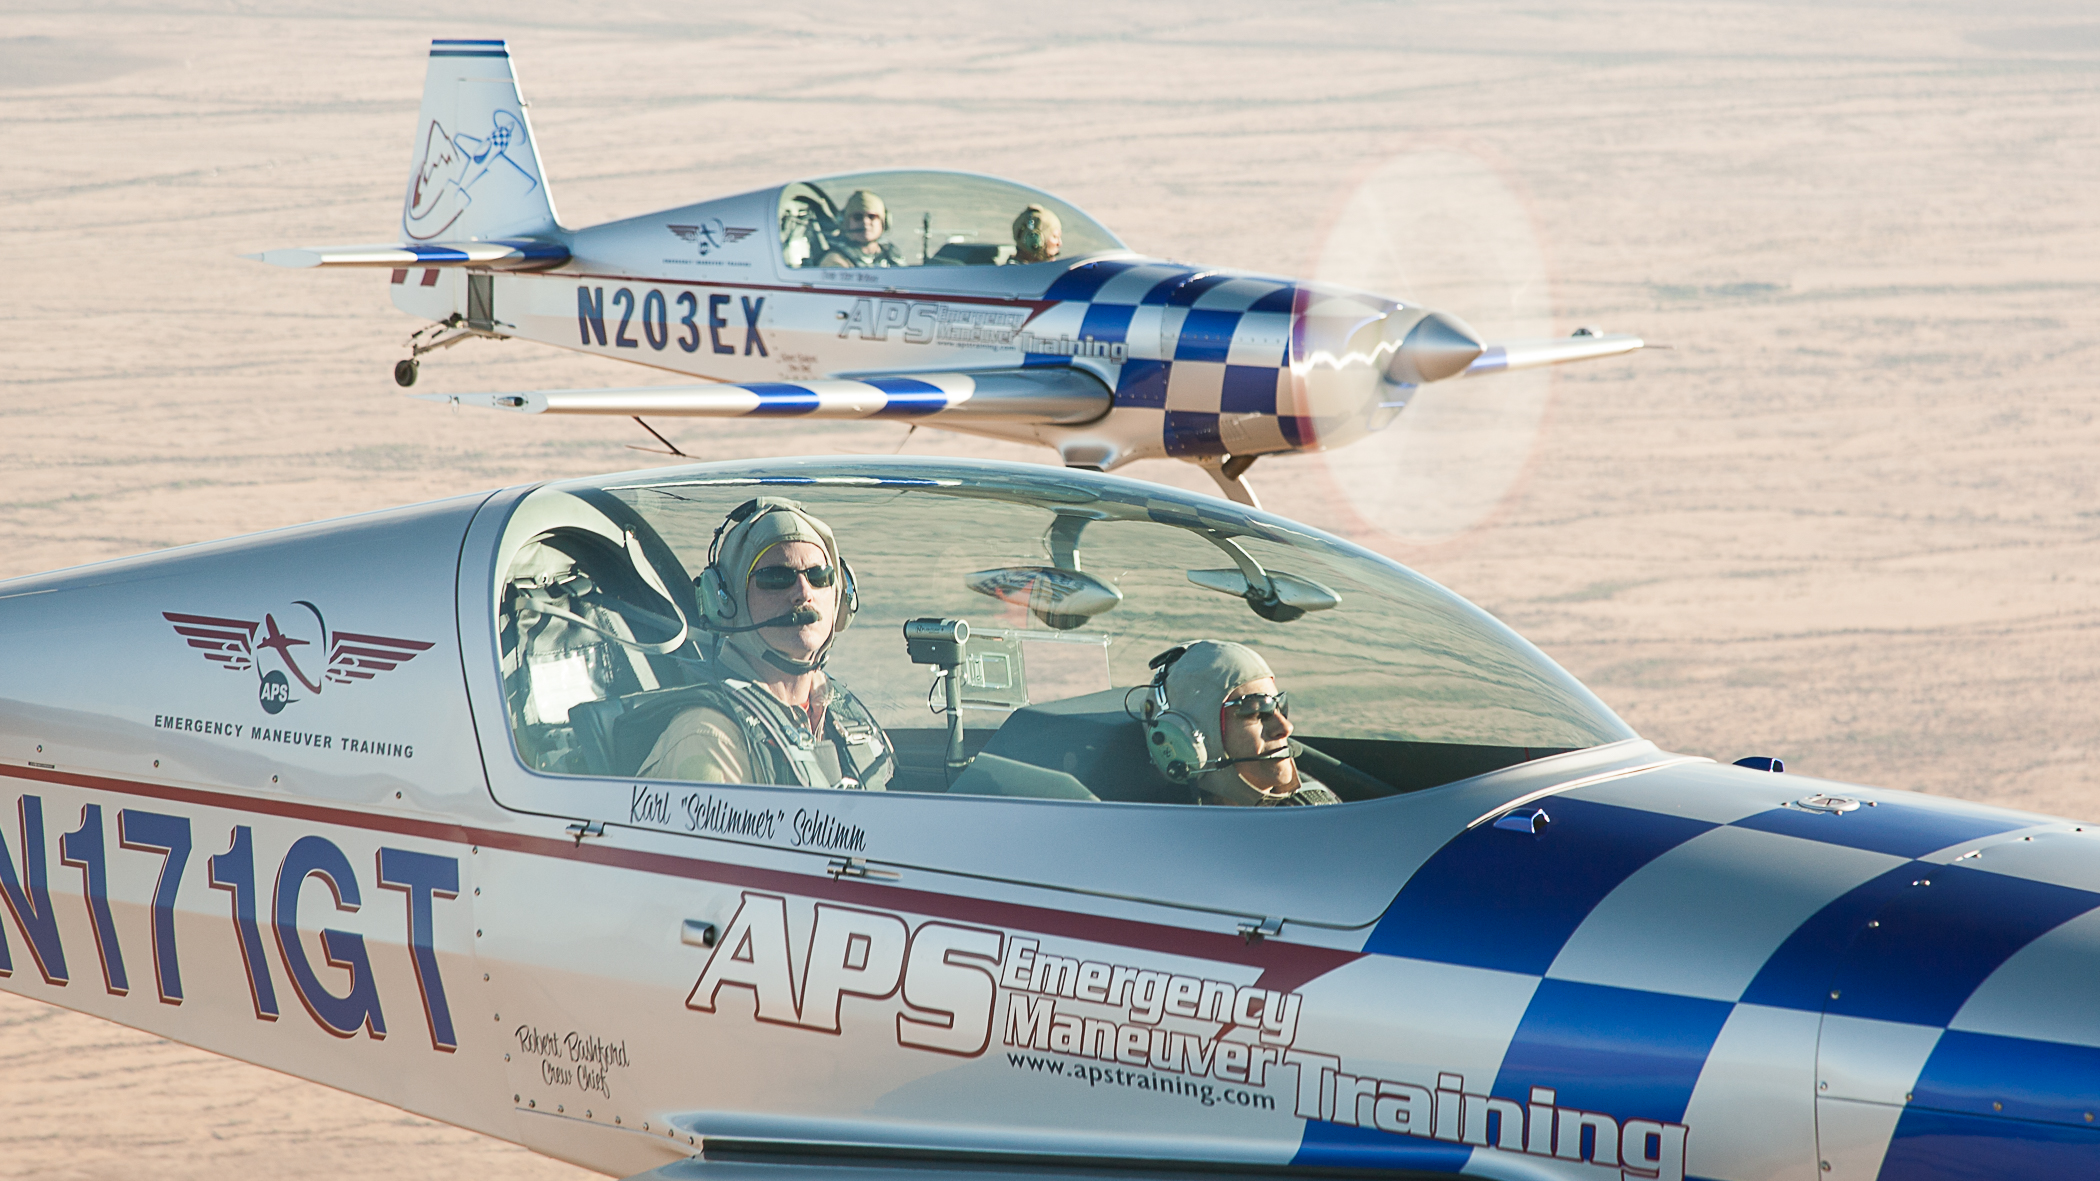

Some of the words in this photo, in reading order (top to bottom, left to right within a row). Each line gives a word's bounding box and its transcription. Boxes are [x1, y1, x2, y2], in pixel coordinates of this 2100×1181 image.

[577, 286, 769, 357] N203EX
[838, 298, 939, 345] APS
[936, 321, 1016, 345] Maneuver
[937, 304, 1024, 331] Emergency
[1017, 331, 1129, 365] Training
[260, 682, 288, 702] APS
[154, 714, 243, 737] EMERGENCY
[251, 726, 332, 749] MANEUVER
[341, 737, 414, 759] TRAINING
[629, 785, 671, 825] Karl
[681, 792, 785, 840] "Schlimmer"
[791, 807, 867, 852] Schlimm
[0, 793, 459, 1054] N171GT
[685, 890, 1005, 1058] APS
[1000, 936, 1303, 1047] Emergency
[514, 1025, 562, 1058] Robert
[564, 1031, 630, 1072] Bashford
[1003, 992, 1278, 1088] Maneuver
[541, 1059, 573, 1085] Crew
[577, 1064, 611, 1099] Chief
[1007, 1052, 1276, 1111] www.apstraining.com
[1283, 1049, 1690, 1181] Training
